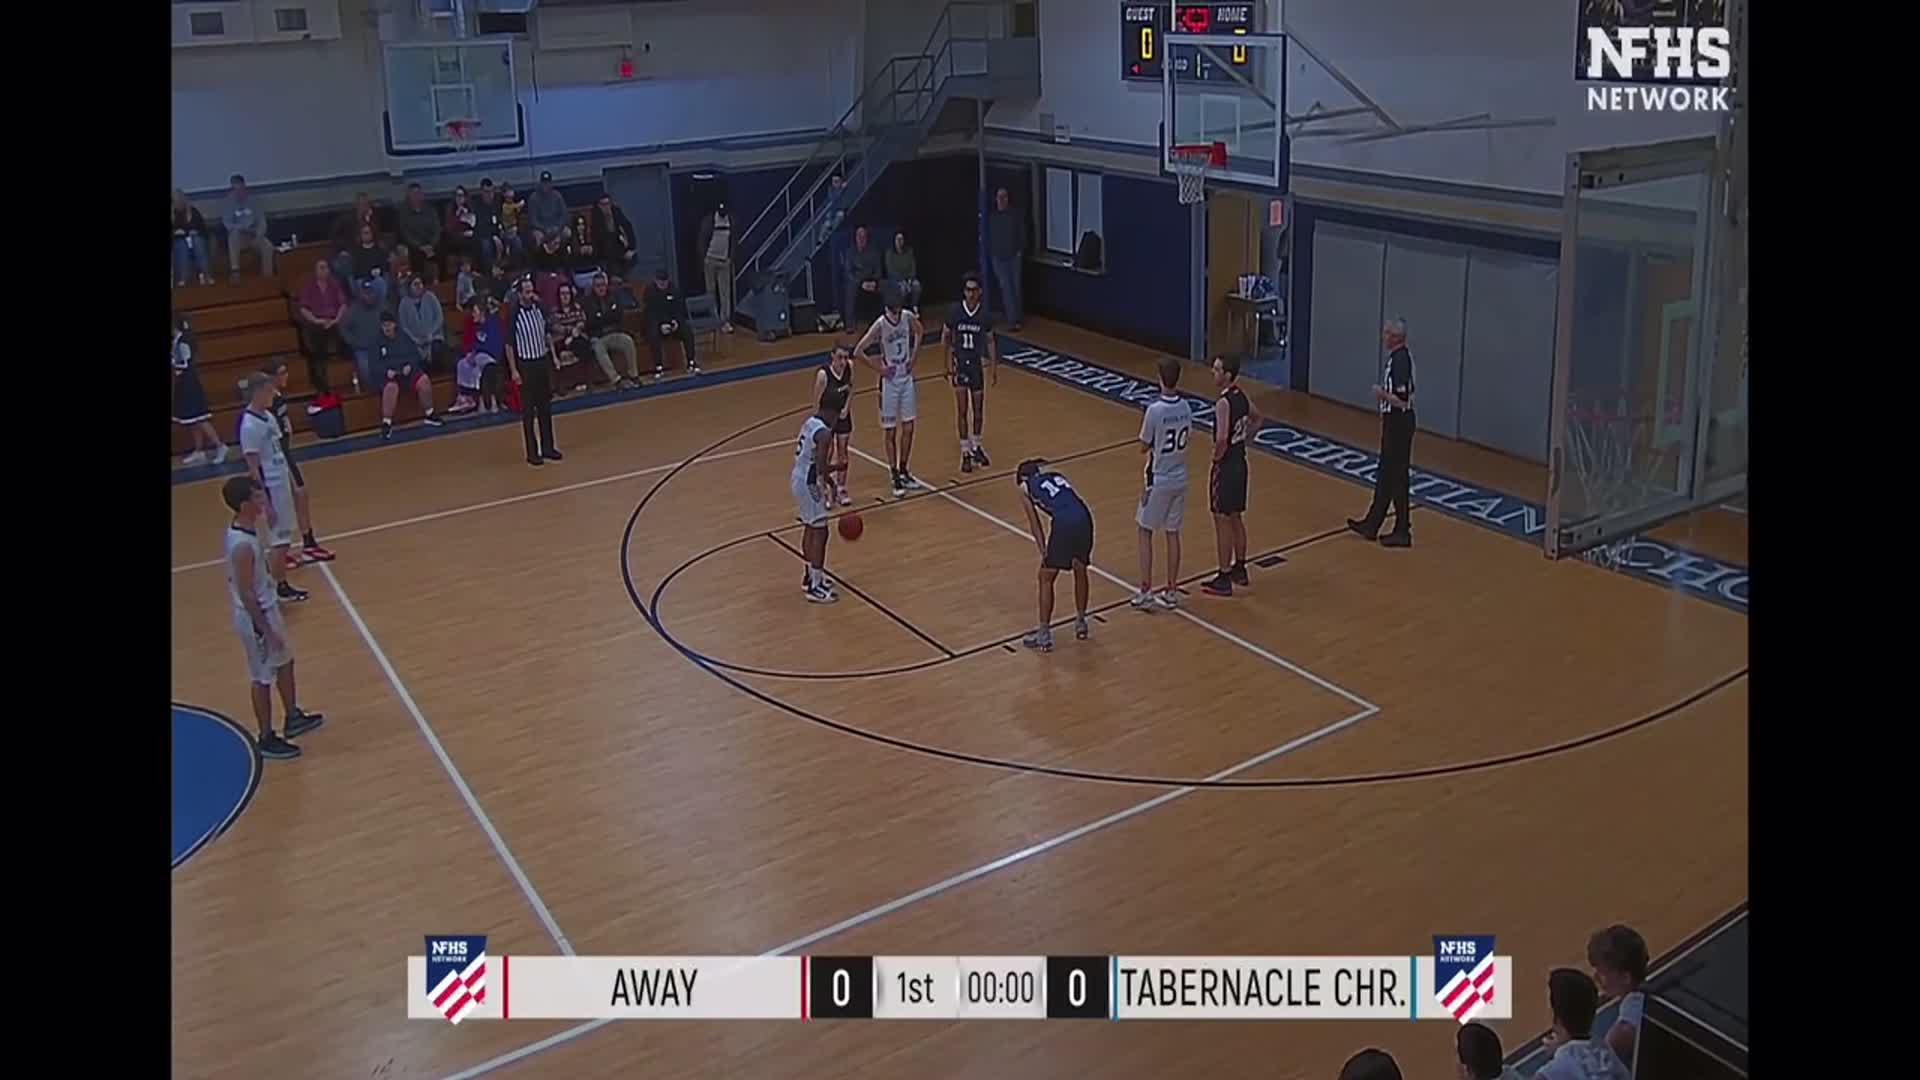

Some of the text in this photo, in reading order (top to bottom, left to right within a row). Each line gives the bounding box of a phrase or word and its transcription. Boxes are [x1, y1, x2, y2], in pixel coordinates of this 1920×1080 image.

[1126, 7, 1155, 21] GUEST
[1217, 7, 1248, 22] HOME
[1141, 27, 1153, 59] 0
[962, 333, 974, 349] 11
[1161, 427, 1190, 454] 30
[1253, 427, 1545, 533] CHRITIAN
